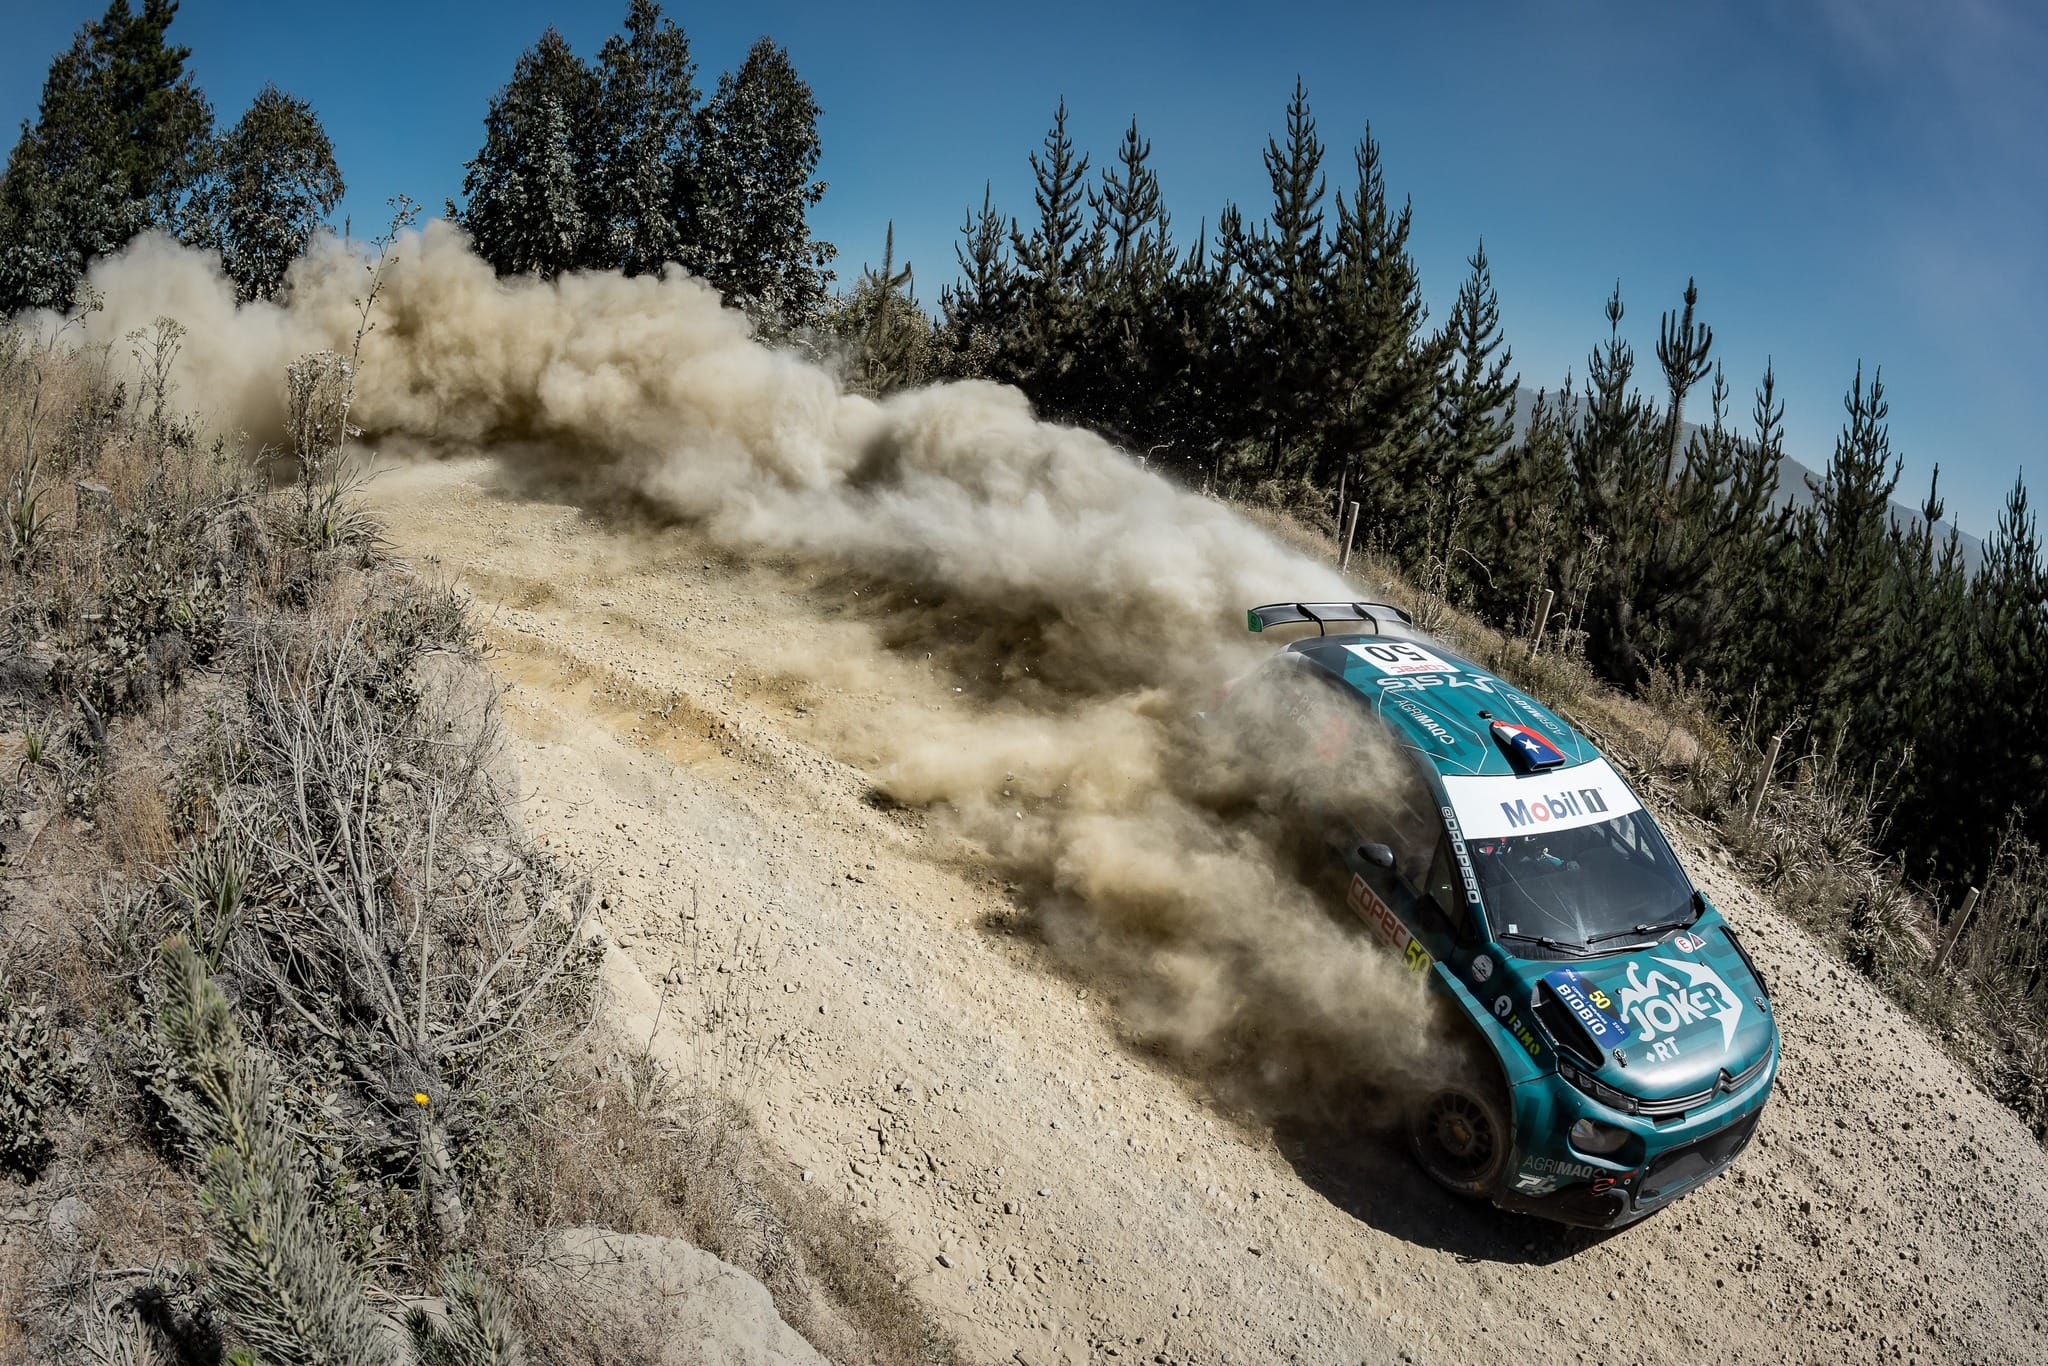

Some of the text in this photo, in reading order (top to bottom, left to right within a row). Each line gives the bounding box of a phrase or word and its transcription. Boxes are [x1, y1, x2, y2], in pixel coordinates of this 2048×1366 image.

[1364, 645, 1428, 662] 50
[1500, 788, 1607, 828] Mobil 1
[1403, 940, 1431, 979] 50
[1589, 990, 1611, 1009] 50
[1630, 984, 1733, 1041] JOKER
[1652, 1036, 1680, 1062] RT
[1522, 1155, 1593, 1179] AGRIMAQ
